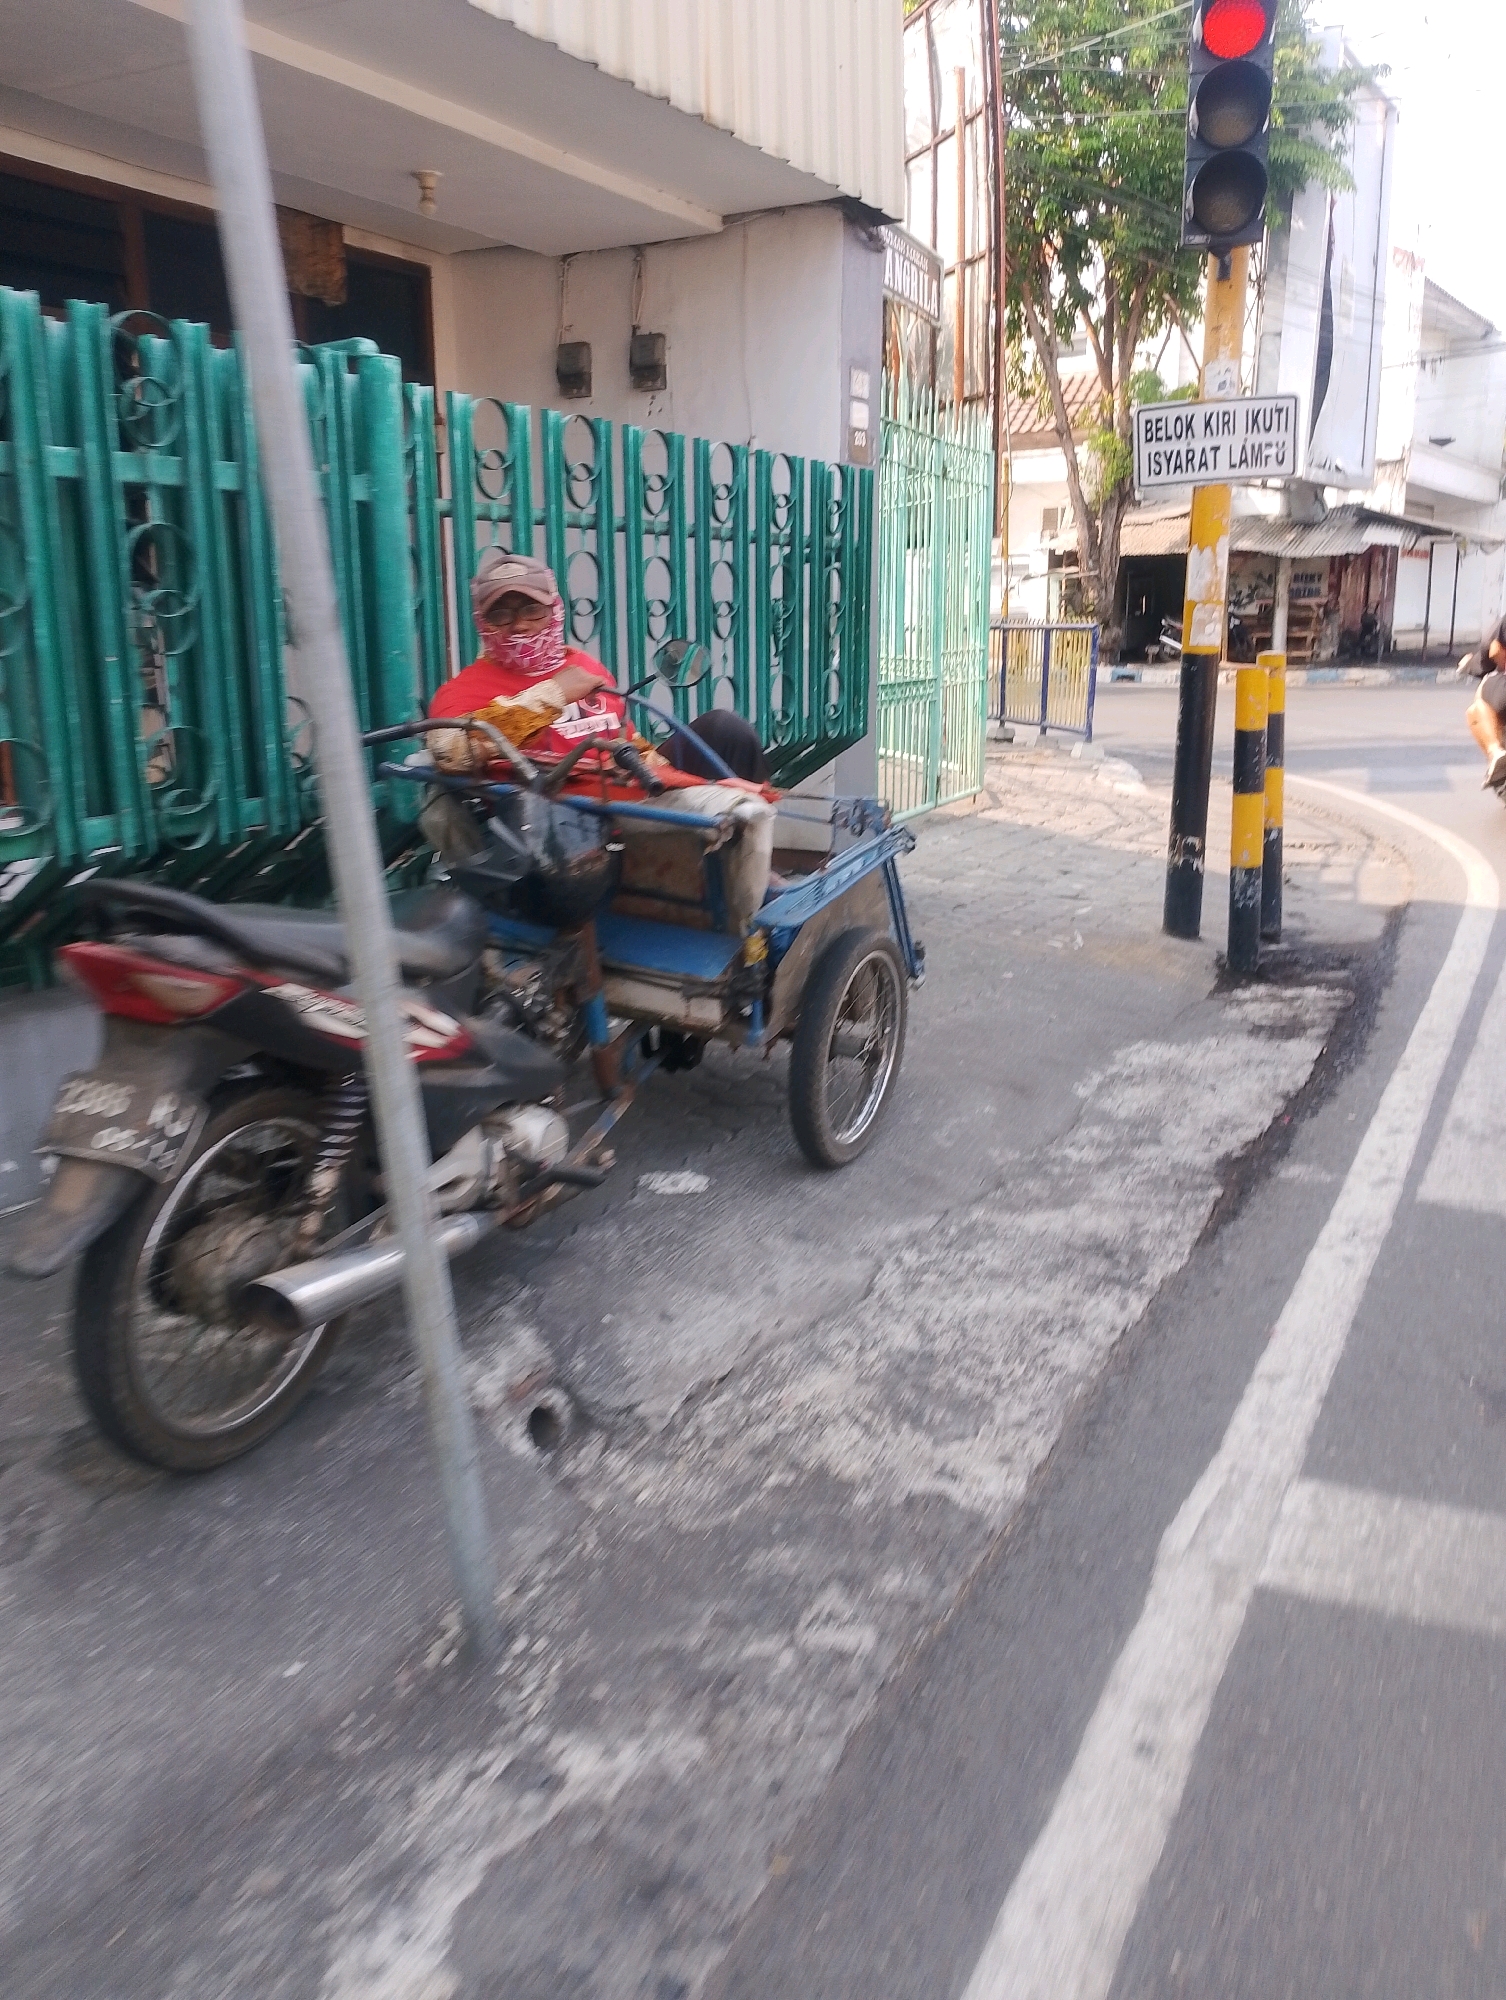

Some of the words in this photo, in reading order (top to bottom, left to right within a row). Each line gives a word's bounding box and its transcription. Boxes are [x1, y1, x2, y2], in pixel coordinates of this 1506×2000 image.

[883, 246, 938, 318] ANGRILA
[1145, 413, 1196, 443] BELOK
[1204, 409, 1236, 437] KIRI
[1245, 406, 1290, 435] IKUTI
[1147, 444, 1221, 477] ISYARAT
[1228, 440, 1286, 470] LAMPU
